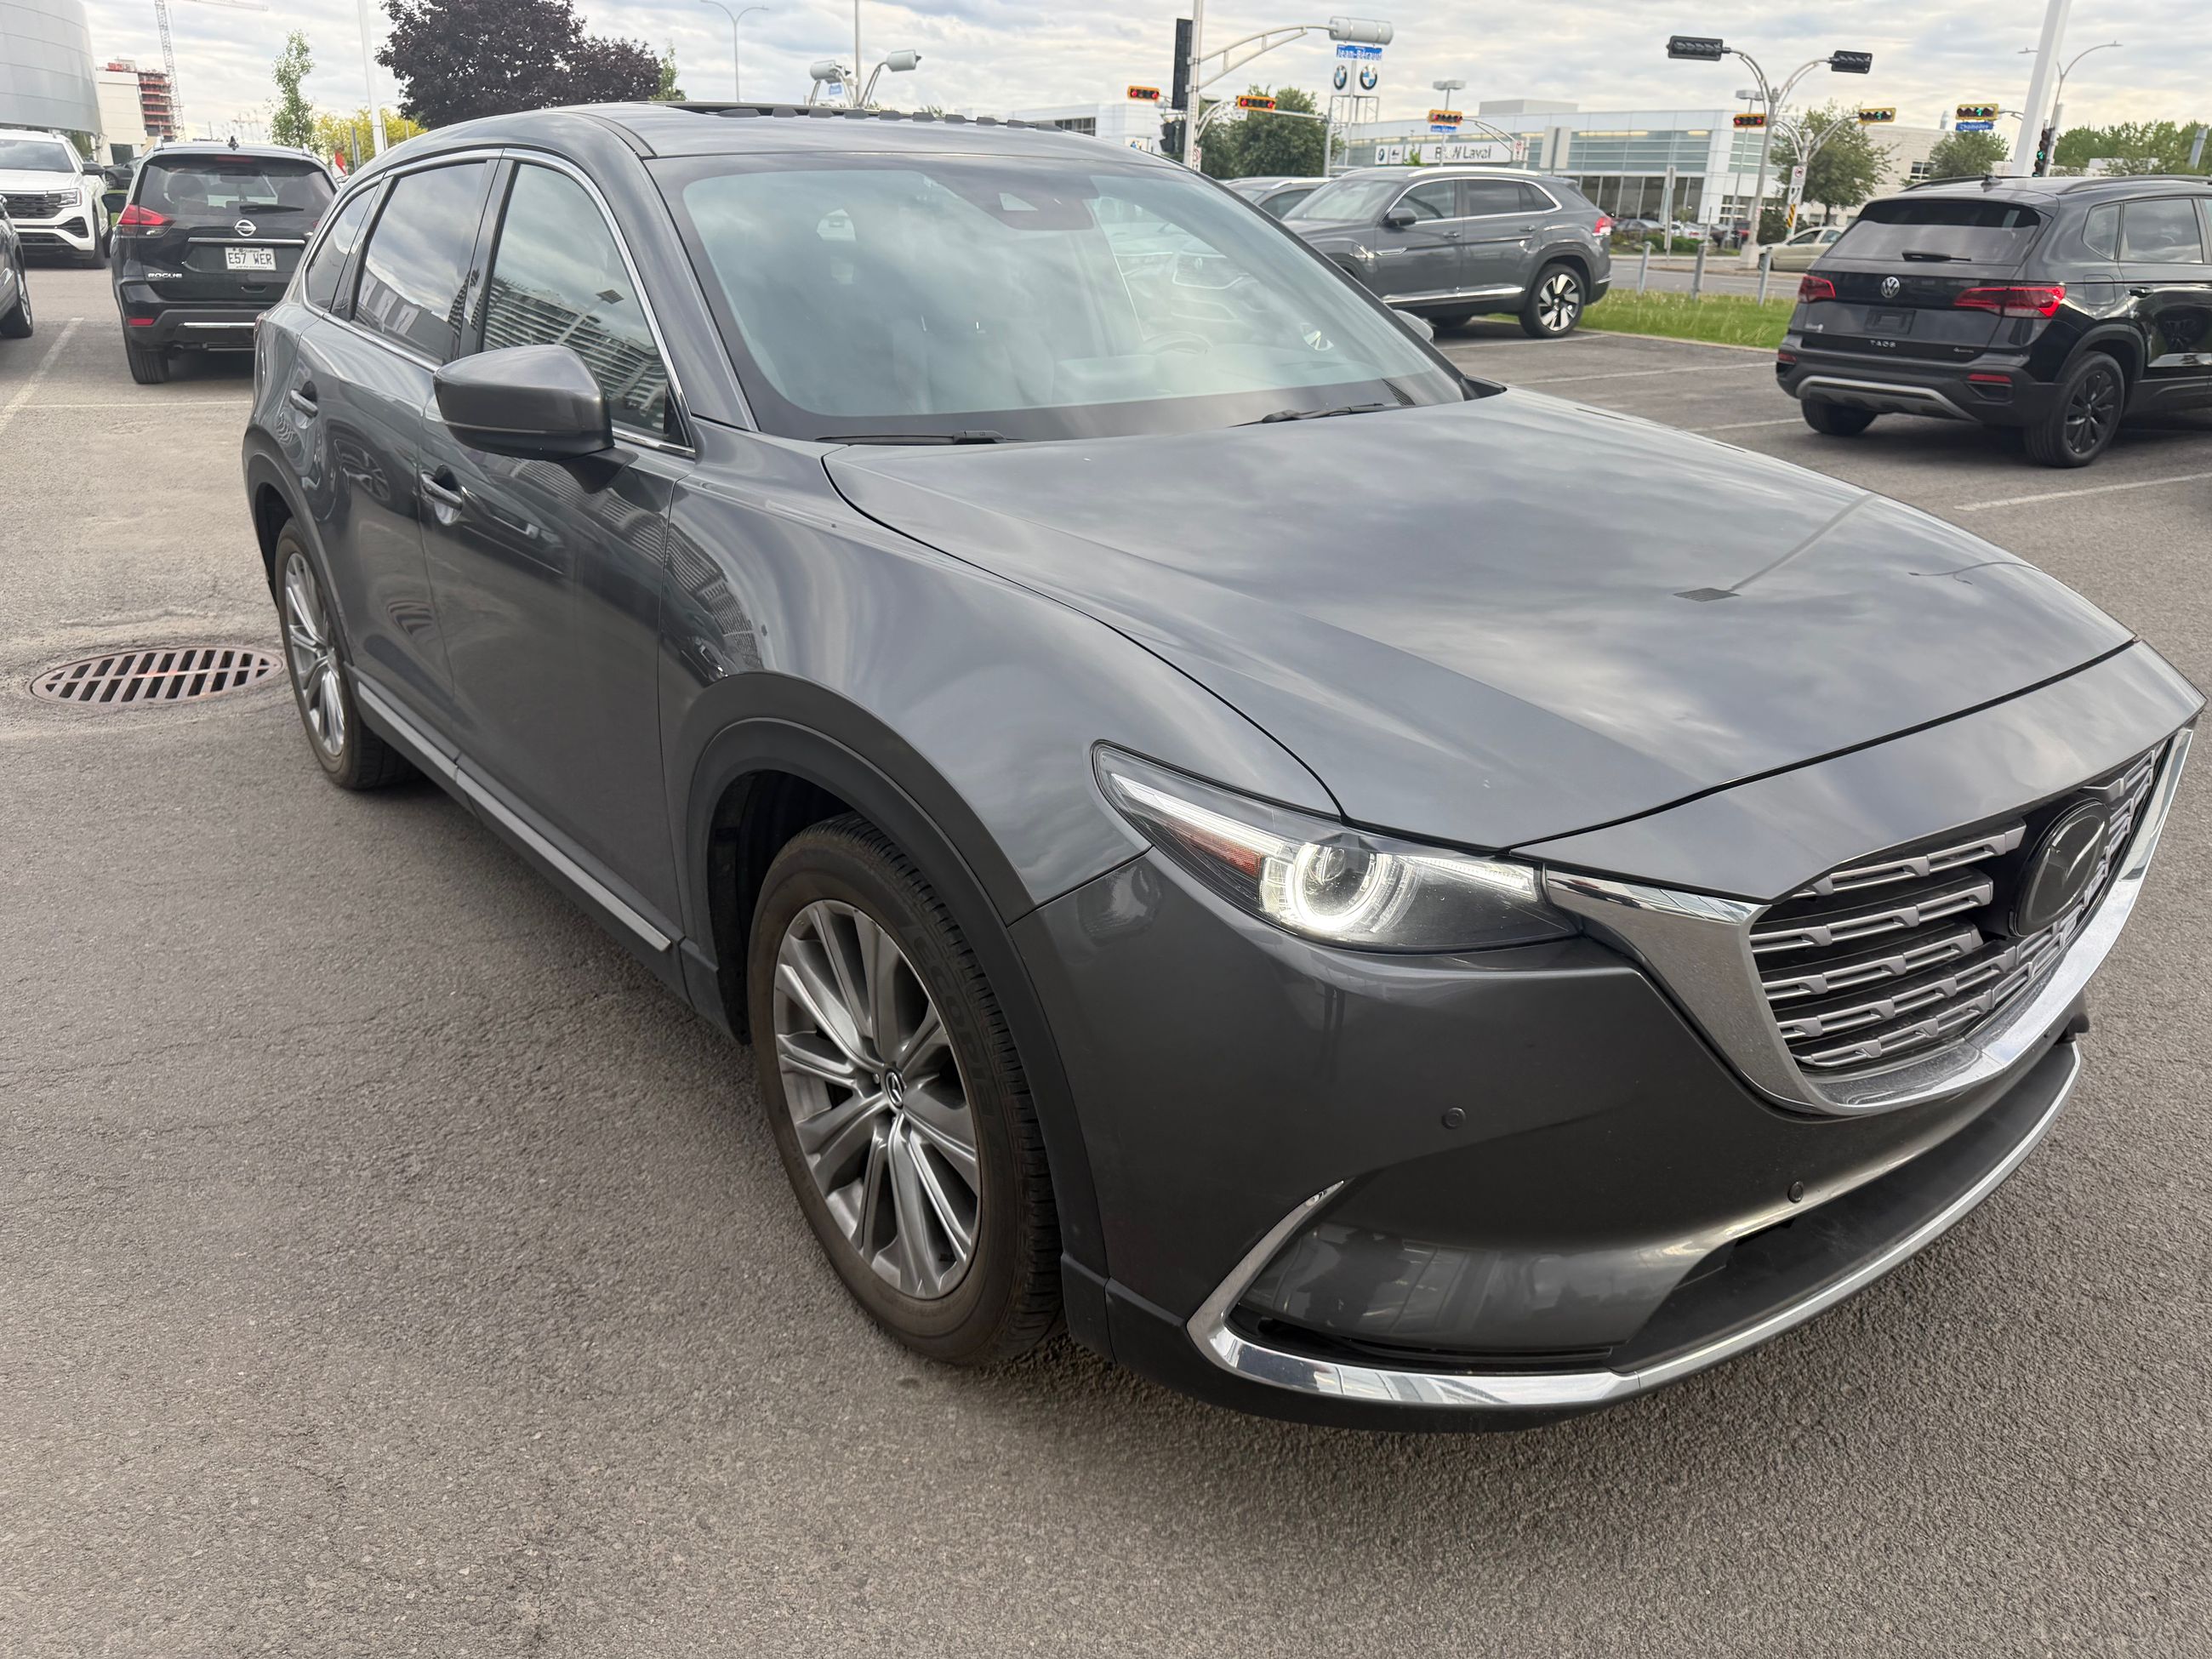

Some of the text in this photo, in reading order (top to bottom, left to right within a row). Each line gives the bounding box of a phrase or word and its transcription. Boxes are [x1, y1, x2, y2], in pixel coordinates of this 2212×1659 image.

[1435, 145, 1492, 159] BW Laval
[228, 253, 272, 265] E57 WER
[1870, 339, 1896, 348] TAOS
